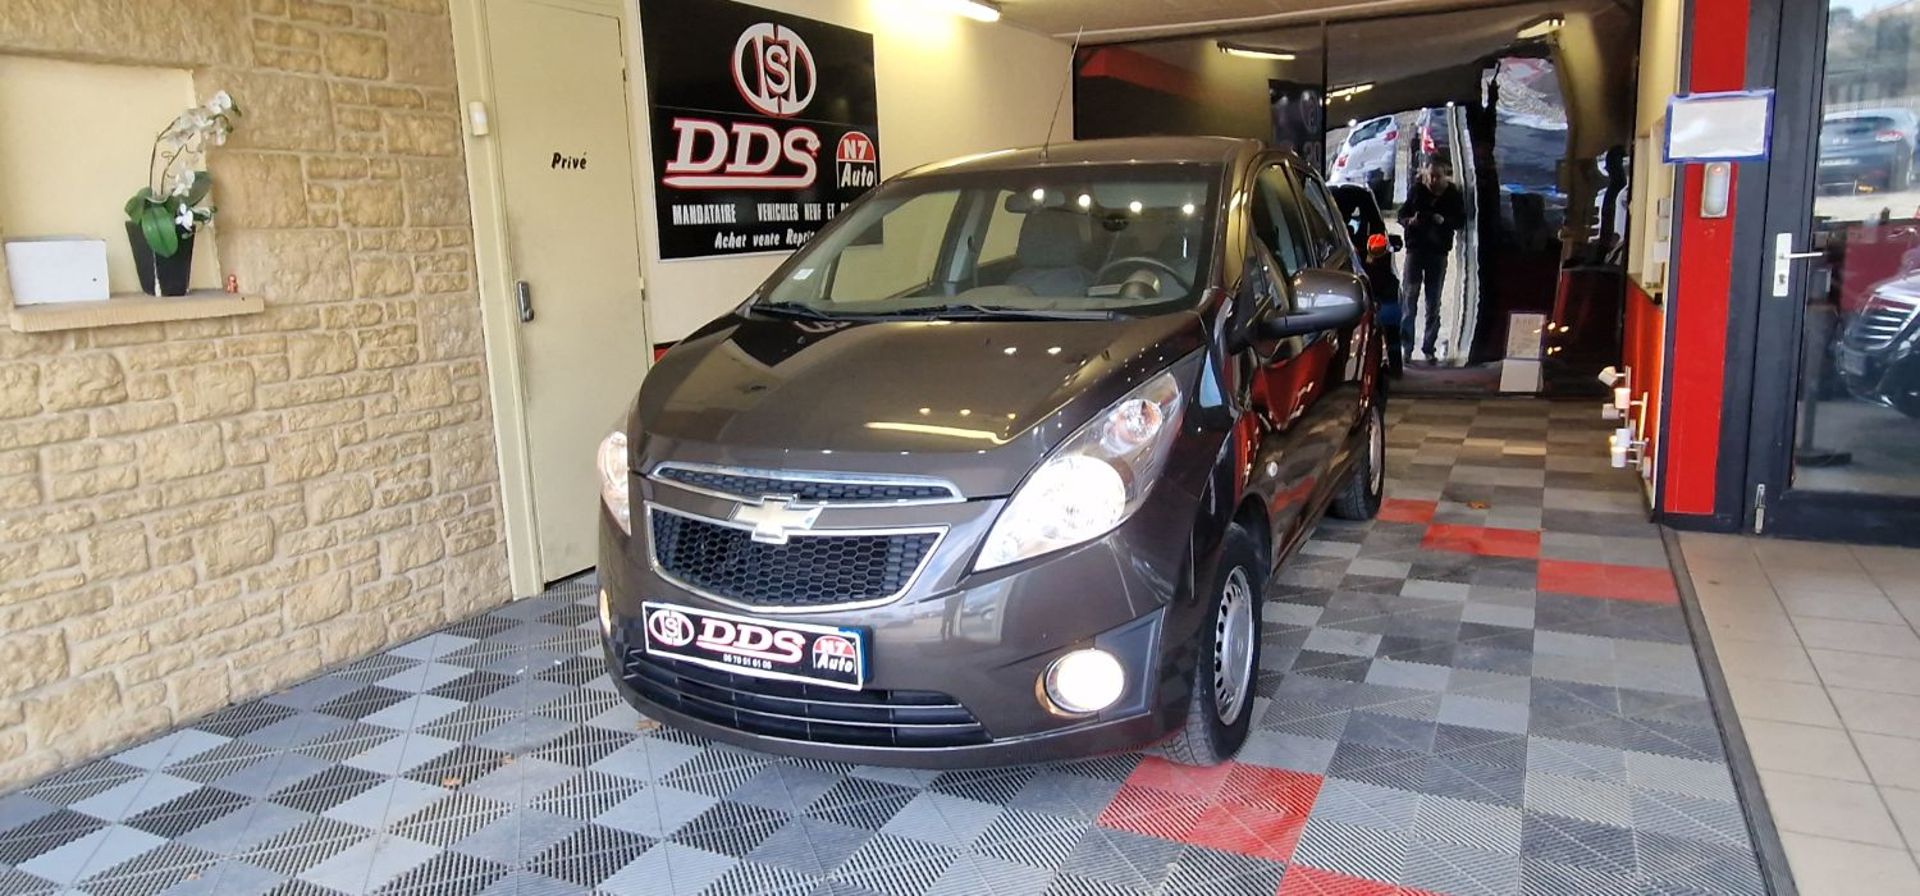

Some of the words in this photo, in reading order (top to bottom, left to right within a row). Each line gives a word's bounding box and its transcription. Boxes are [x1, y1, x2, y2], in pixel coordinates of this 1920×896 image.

[551, 151, 587, 170] Privé
[664, 117, 821, 189] DDS
[843, 138, 868, 160] N7
[840, 161, 874, 188] Auto
[672, 203, 737, 226] MANDATAIRE
[827, 202, 835, 220] ET
[714, 231, 747, 250] Achat
[753, 232, 780, 247] vente
[696, 617, 806, 664] DDS
[817, 651, 854, 673] Auto
